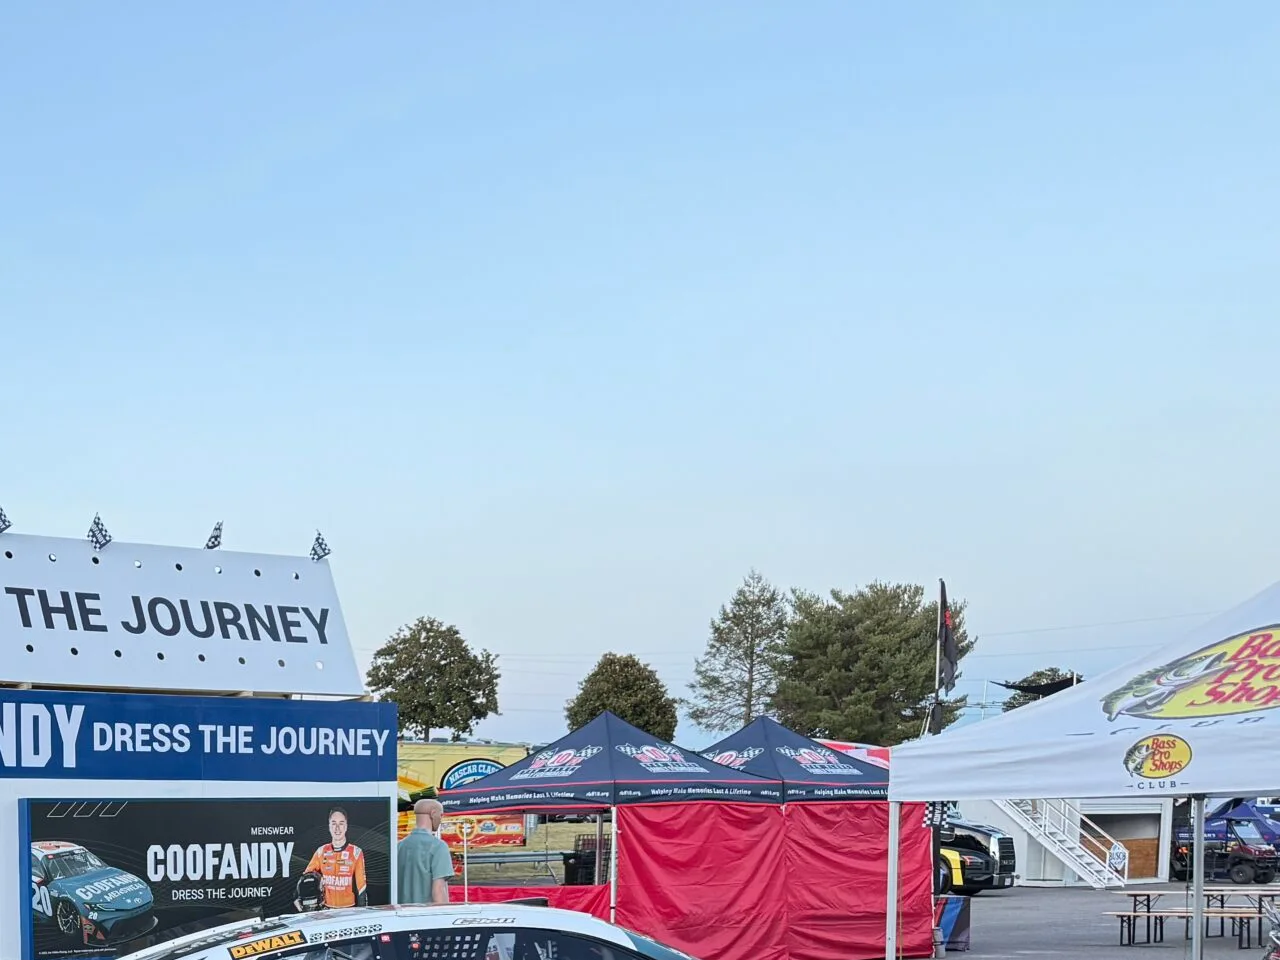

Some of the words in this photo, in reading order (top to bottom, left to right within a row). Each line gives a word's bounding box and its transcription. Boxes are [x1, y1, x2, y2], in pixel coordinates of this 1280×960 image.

[5, 586, 108, 633] THE
[121, 596, 329, 645] JOURNEY
[93, 721, 190, 754] DRESS
[199, 724, 253, 755] THE
[260, 727, 390, 758] JOURNEY
[1151, 738, 1177, 749] Bass
[1151, 749, 1170, 760] Pro
[1149, 760, 1183, 772] Shops
[449, 764, 477, 784] NASCAR
[1137, 781, 1177, 789] CLUB
[250, 826, 295, 836] MENSWEAR
[146, 842, 295, 883] COOFANDY
[172, 889, 204, 901] DRESS
[205, 888, 226, 900] THE
[227, 886, 273, 899] JOURNEY
[88, 911, 98, 920] 20
